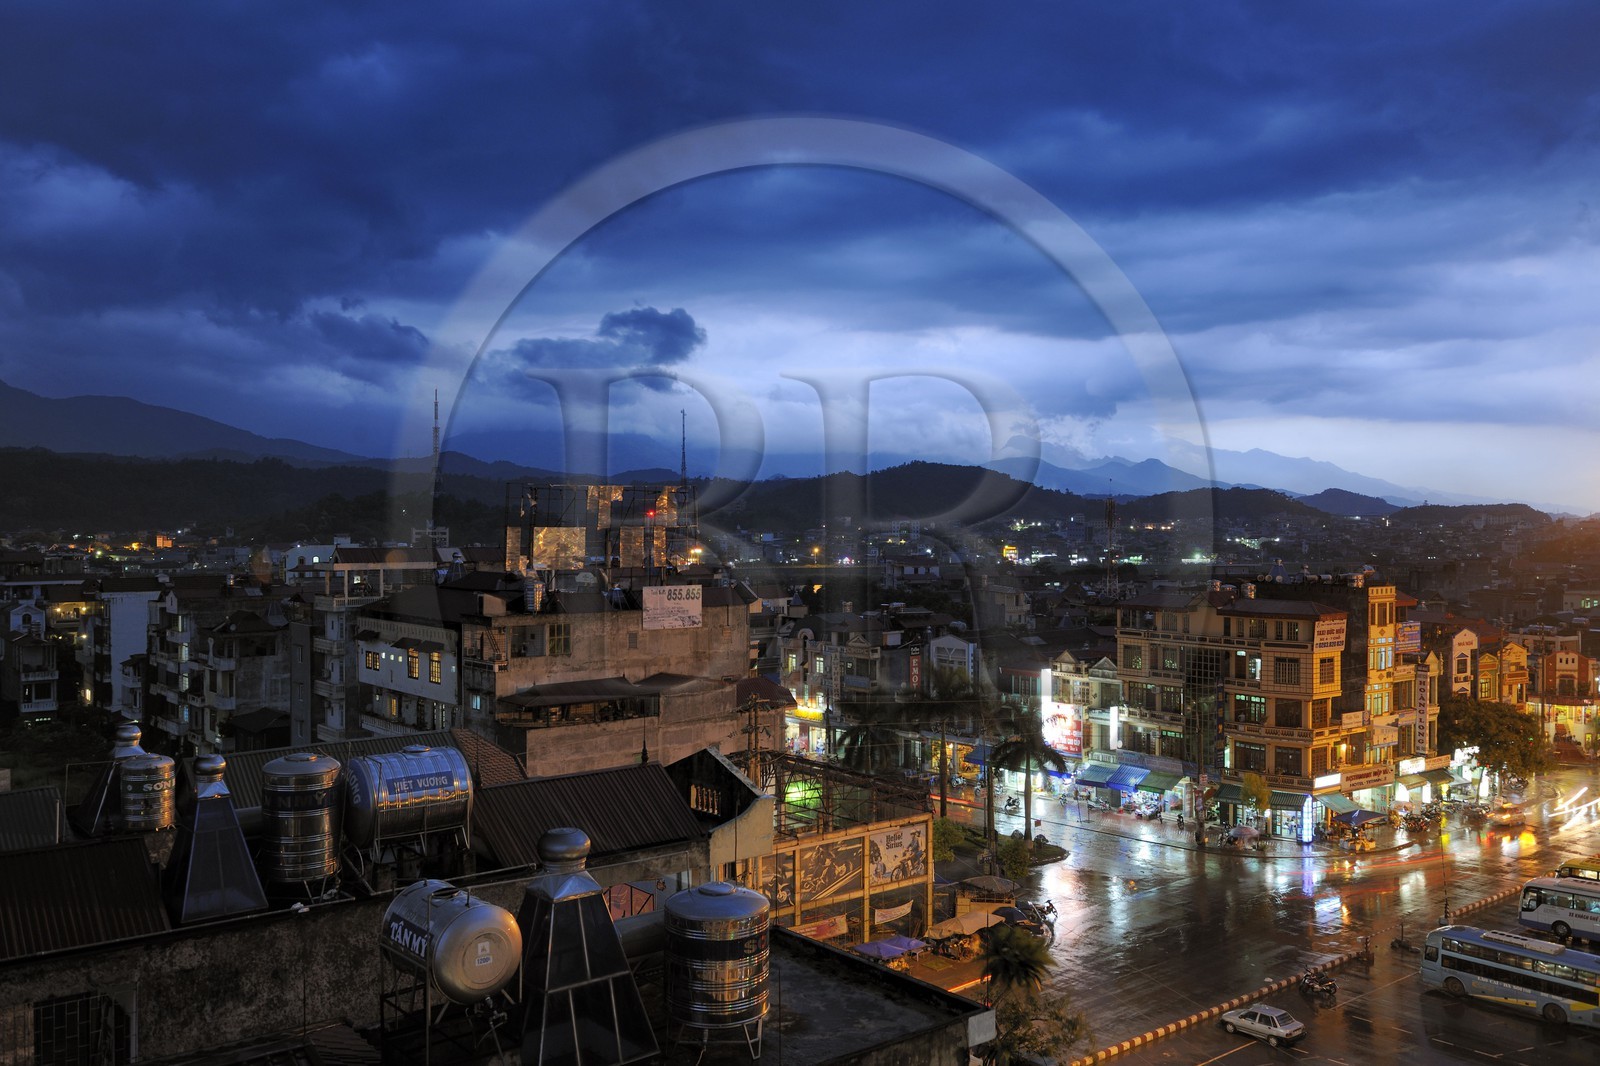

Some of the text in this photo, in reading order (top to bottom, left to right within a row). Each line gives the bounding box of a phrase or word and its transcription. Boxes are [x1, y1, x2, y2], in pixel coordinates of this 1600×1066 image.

[667, 588, 701, 601] 855.855
[1418, 681, 1426, 715] HOÀNG
[1417, 718, 1425, 744] LONG
[393, 775, 449, 793] VIỆT VƯƠNG
[886, 832, 903, 843] Hello!
[886, 841, 903, 850] Sirius
